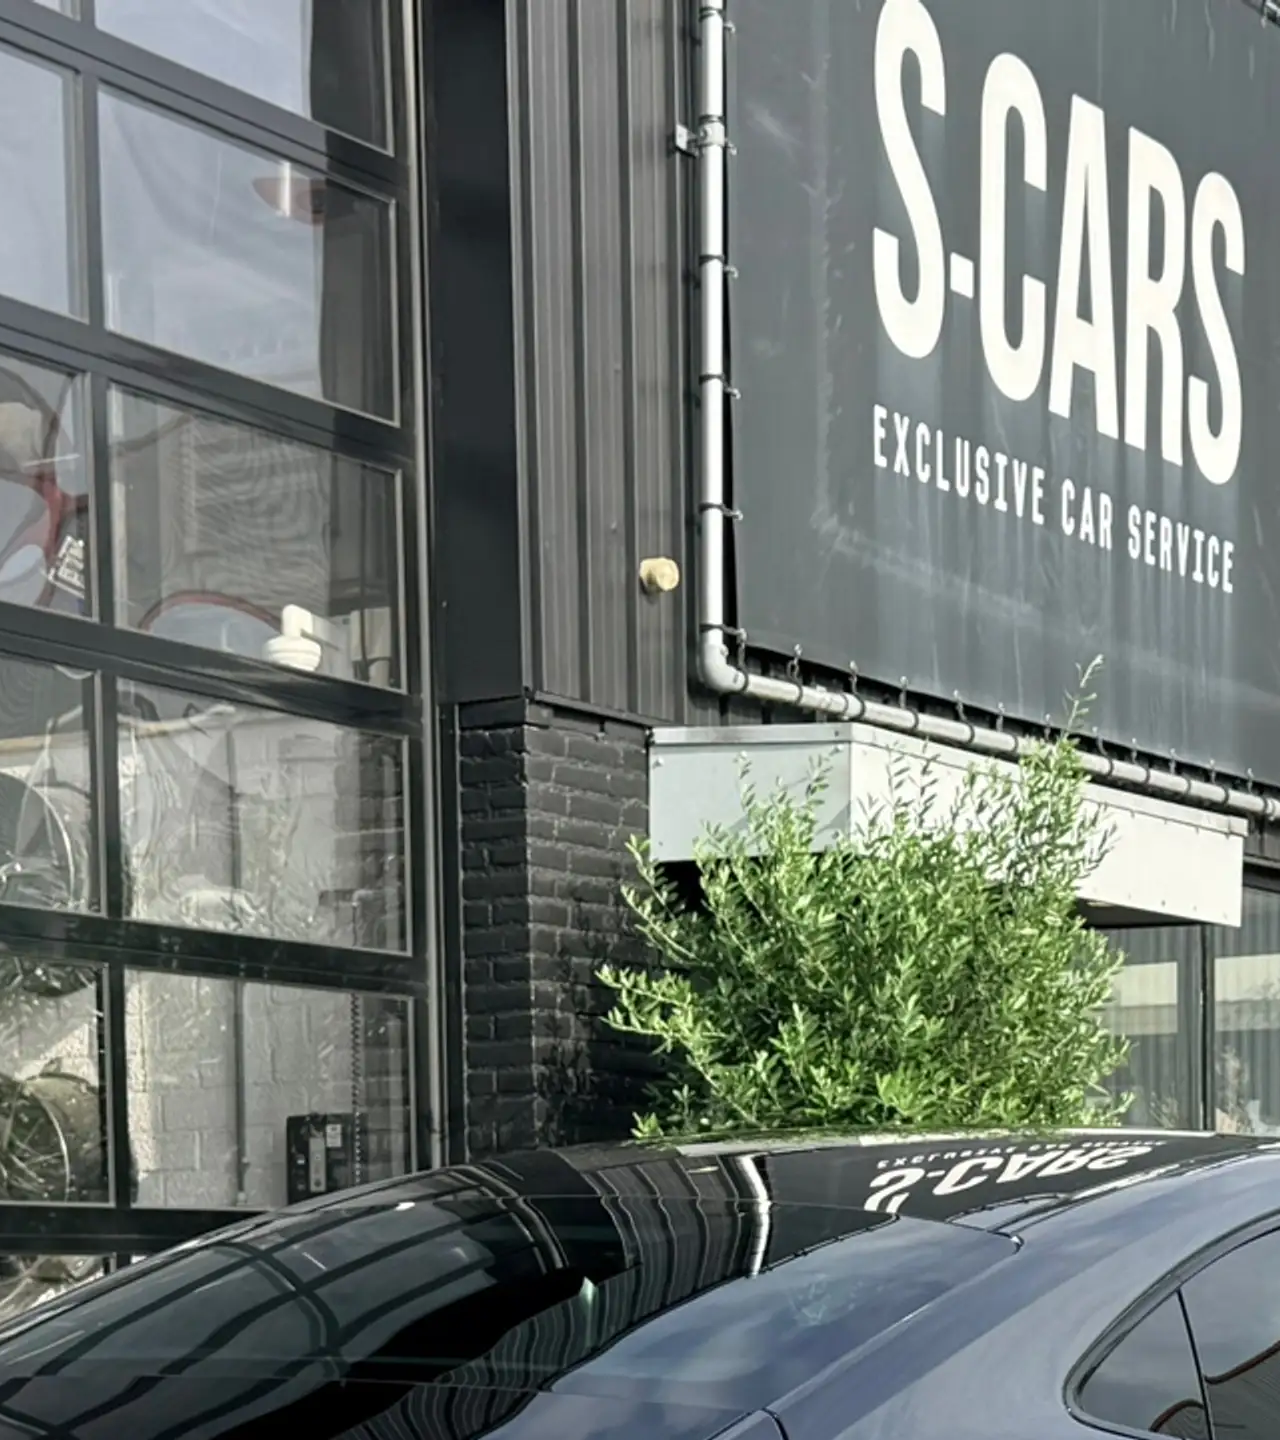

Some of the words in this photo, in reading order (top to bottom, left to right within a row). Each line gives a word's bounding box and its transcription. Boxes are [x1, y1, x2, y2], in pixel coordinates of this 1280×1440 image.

[873, 0, 1245, 485] S-CARS
[874, 404, 1046, 525] EXCLUSIVE
[1061, 478, 1113, 550] CAR
[1127, 505, 1234, 594] SERVICE
